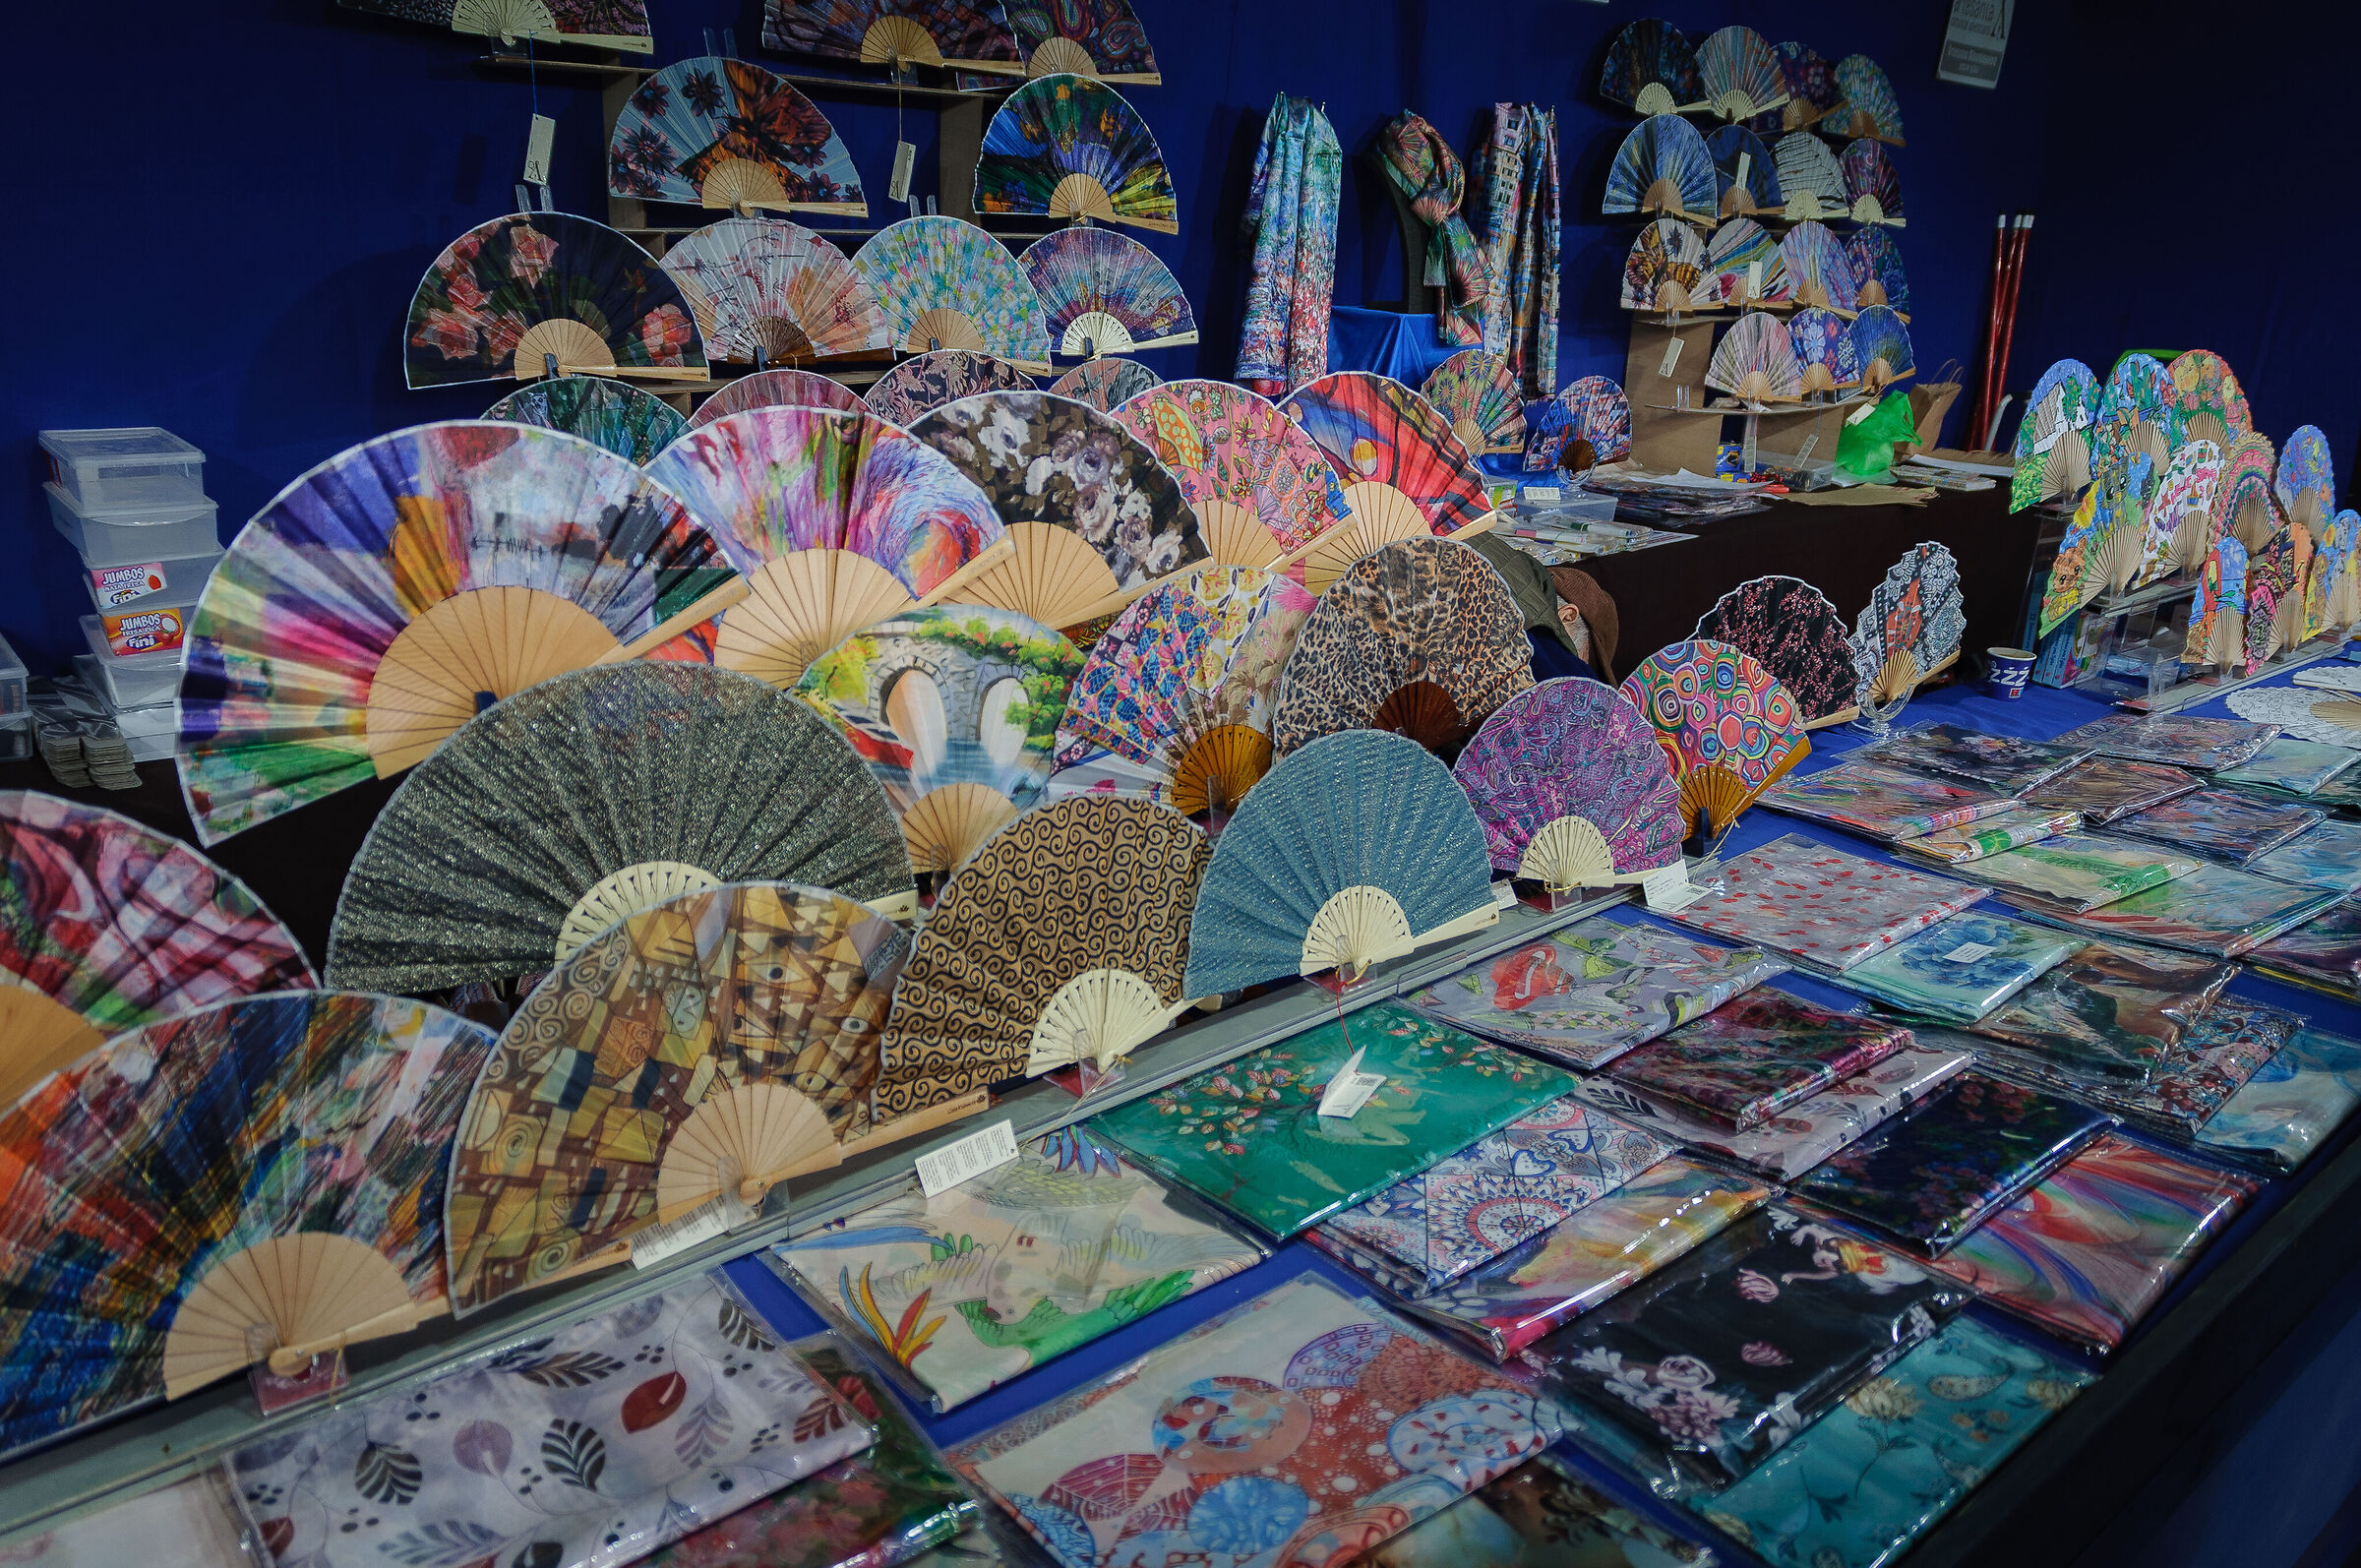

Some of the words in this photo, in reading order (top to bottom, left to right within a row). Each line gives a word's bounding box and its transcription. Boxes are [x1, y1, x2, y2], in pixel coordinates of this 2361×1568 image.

[102, 567, 145, 585] JUMBOS
[119, 613, 161, 631] JUMBOS
[128, 635, 155, 648] Fini
